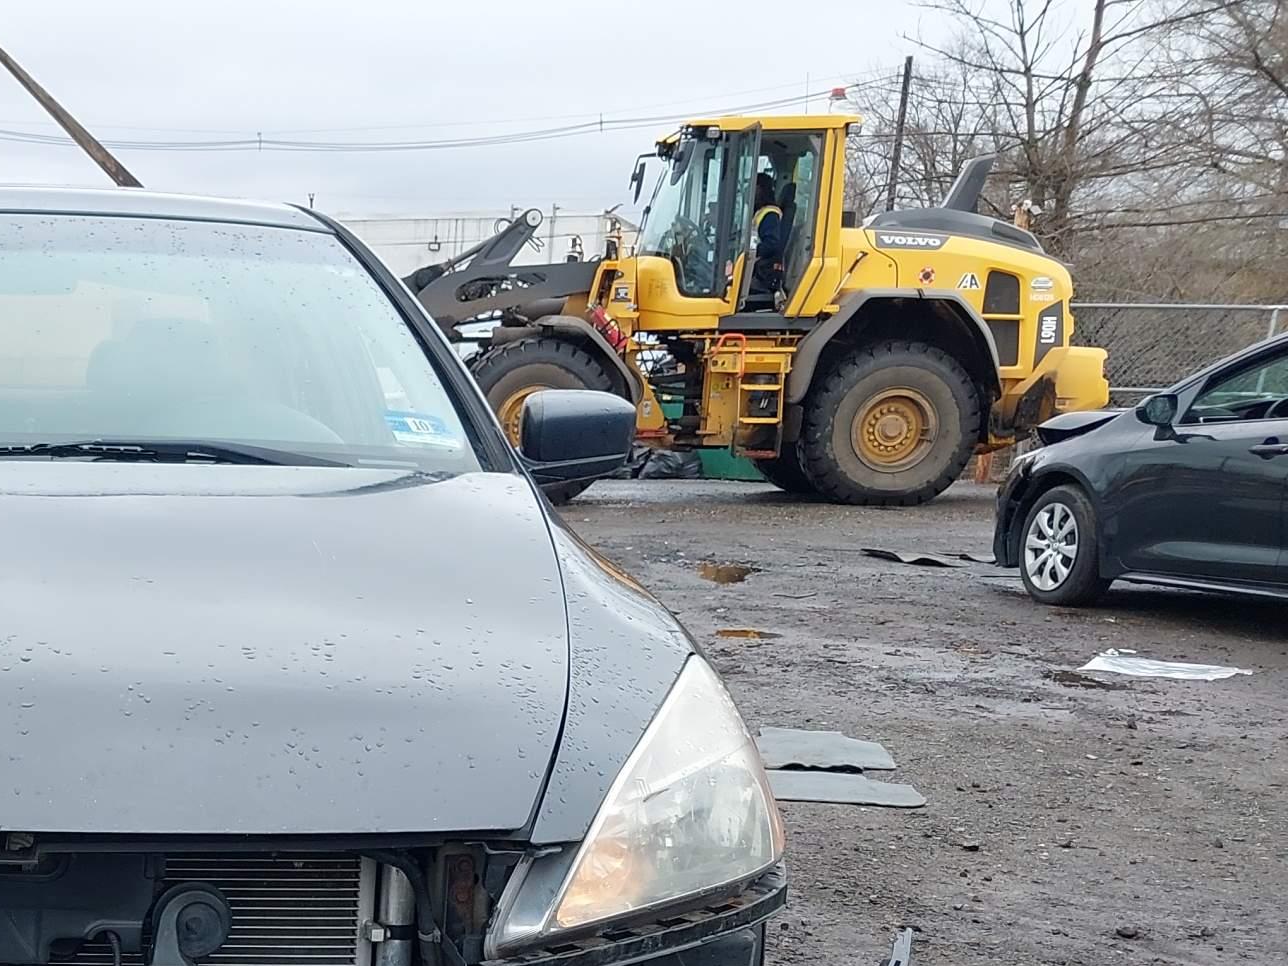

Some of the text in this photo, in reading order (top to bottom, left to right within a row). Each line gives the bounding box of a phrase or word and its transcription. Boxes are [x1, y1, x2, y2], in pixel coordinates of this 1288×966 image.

[880, 235, 941, 247] VOLVO
[1040, 316, 1057, 344] L90H
[412, 419, 430, 432] 10
